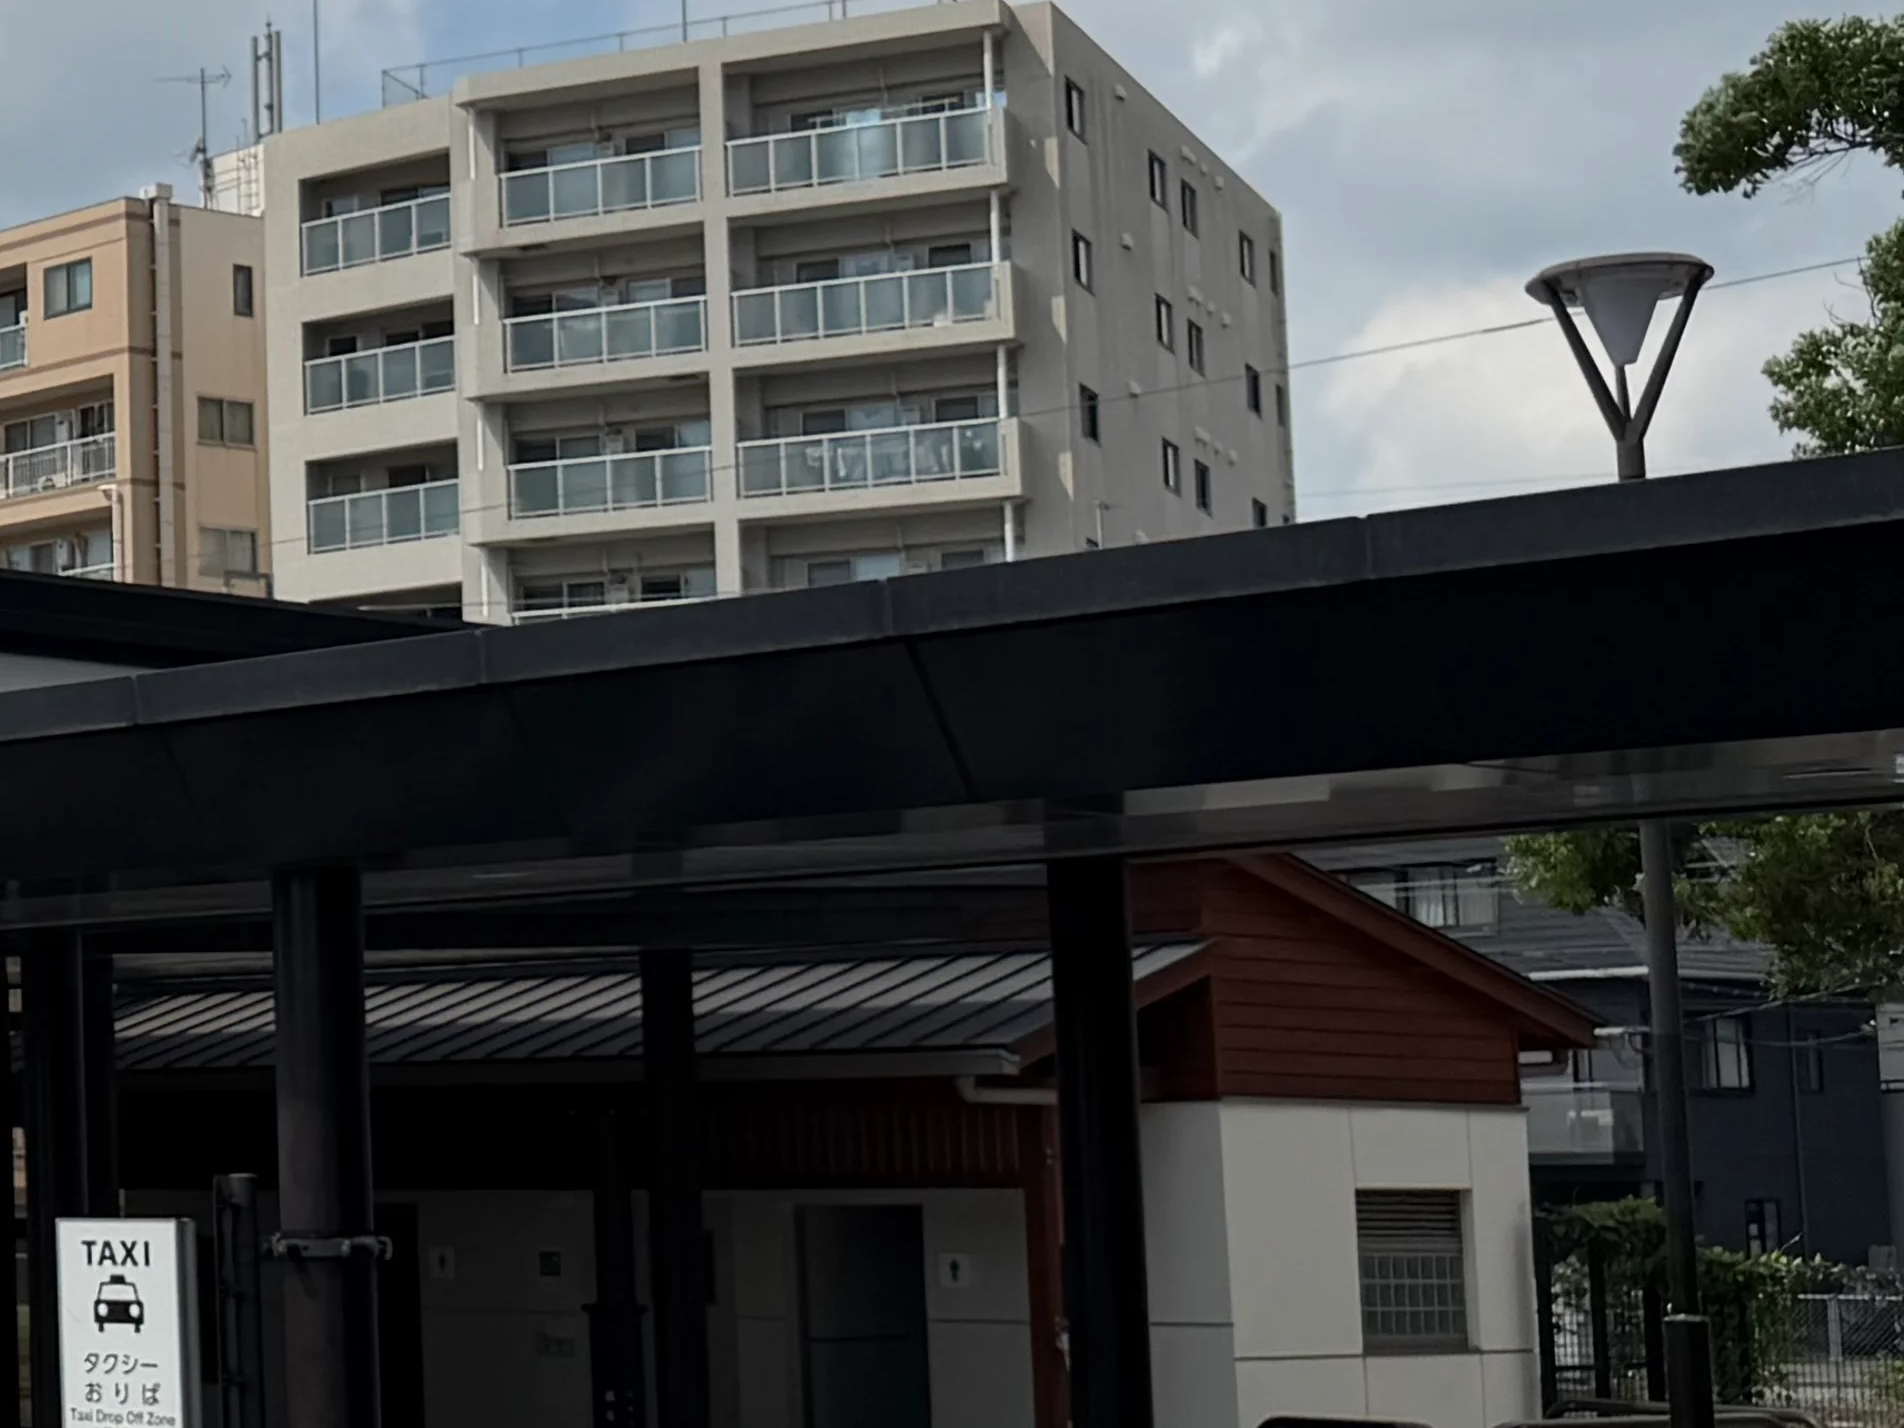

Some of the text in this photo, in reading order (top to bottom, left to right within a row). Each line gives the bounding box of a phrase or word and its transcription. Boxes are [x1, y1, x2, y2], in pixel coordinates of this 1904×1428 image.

[81, 1240, 151, 1267] TAXI
[83, 1352, 158, 1375] タクシー
[85, 1382, 161, 1406] おりば
[95, 1409, 124, 1424] Drop
[126, 1411, 144, 1424] Off
[146, 1412, 176, 1427] Zone
